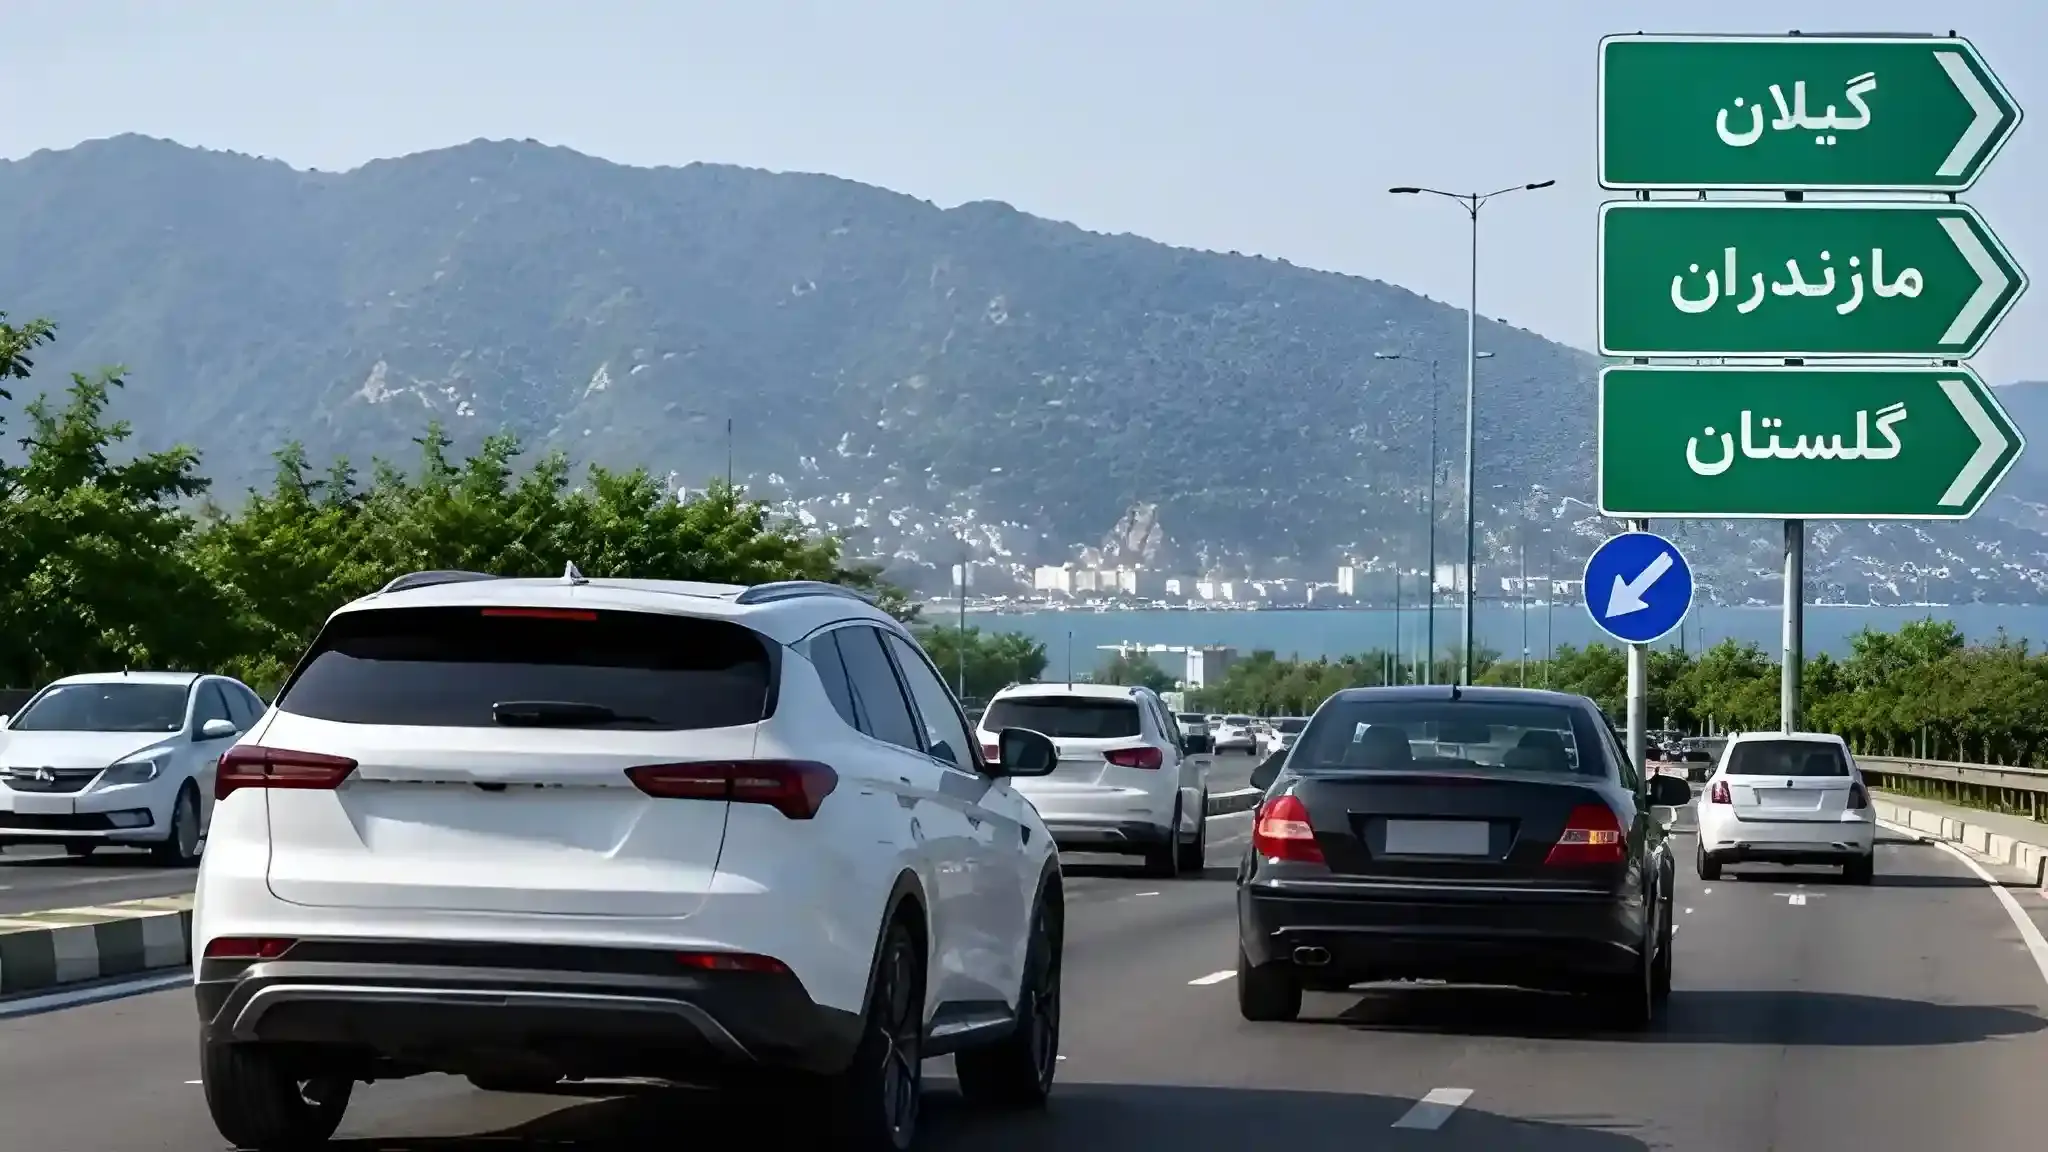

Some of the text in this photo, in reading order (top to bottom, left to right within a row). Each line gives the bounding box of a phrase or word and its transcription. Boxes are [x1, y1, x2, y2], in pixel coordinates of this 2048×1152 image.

[1716, 71, 1877, 147] گیلان
[1670, 246, 1924, 314] مازندران
[1686, 401, 1907, 475] گلستان
